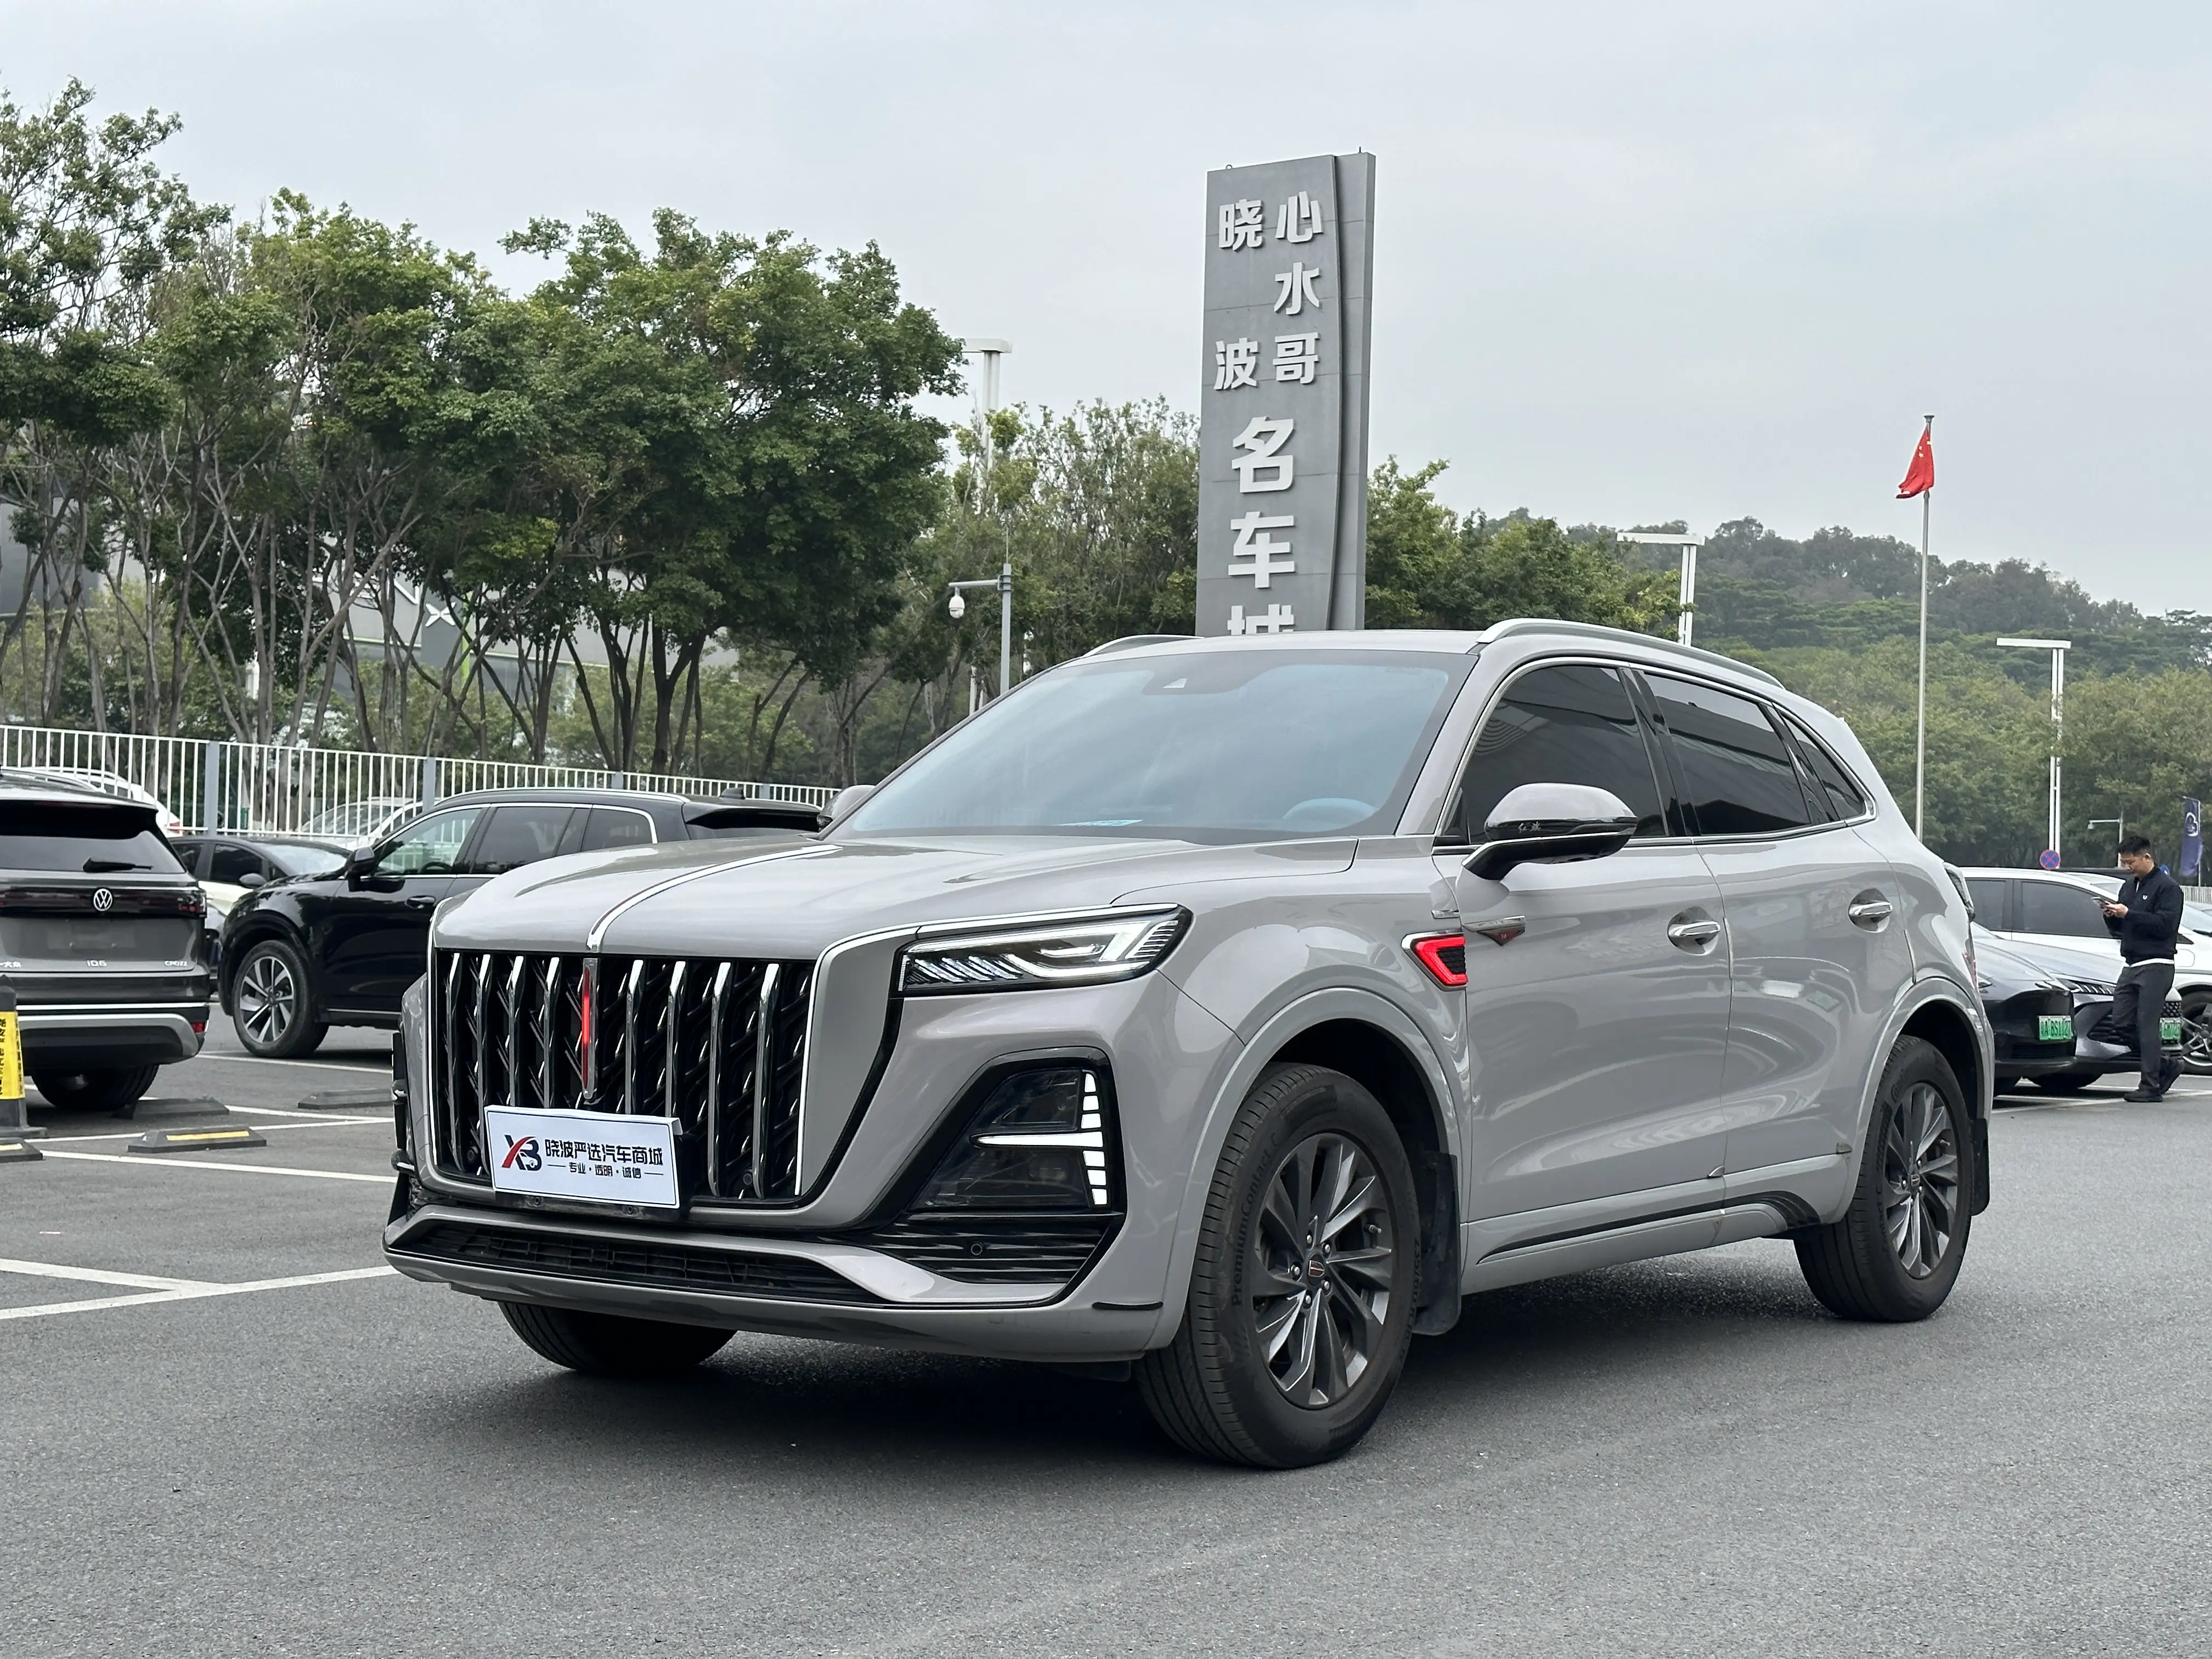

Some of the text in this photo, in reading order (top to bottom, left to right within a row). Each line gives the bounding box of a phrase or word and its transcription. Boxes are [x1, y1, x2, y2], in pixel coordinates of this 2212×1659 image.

[1273, 191, 1322, 384] 心水哥
[1517, 821, 1541, 833] 红旗
[545, 1139, 663, 1165] 晓波严选汽车商城
[1231, 1149, 1272, 1306] PremiumContact
